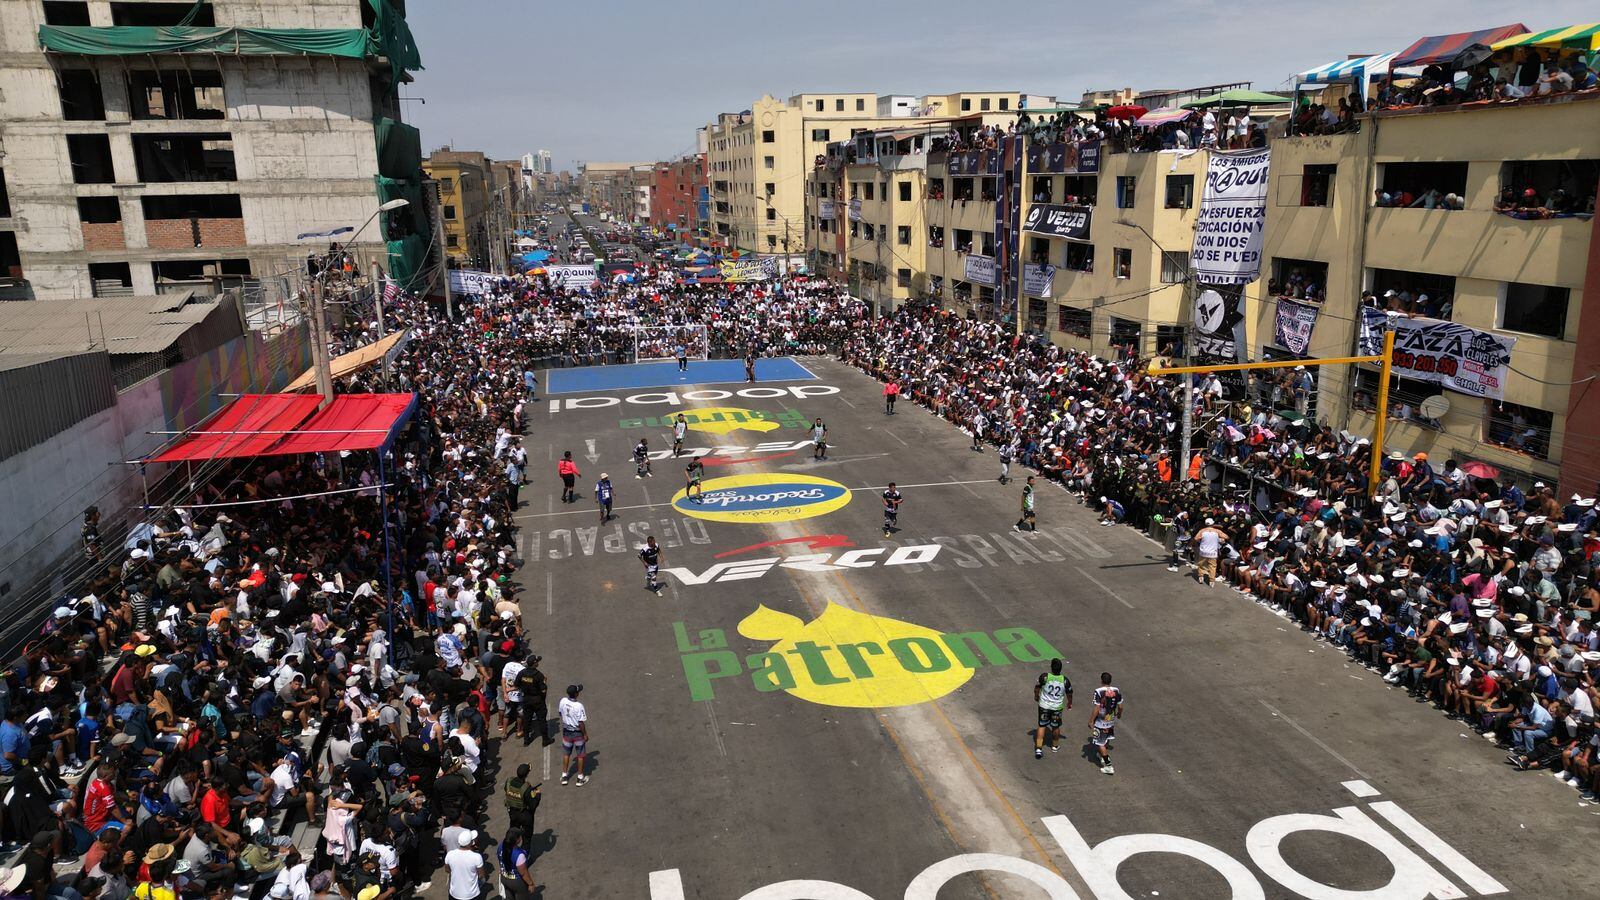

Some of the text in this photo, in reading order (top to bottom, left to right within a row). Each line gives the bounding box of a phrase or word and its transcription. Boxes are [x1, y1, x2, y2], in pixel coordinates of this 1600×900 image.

[1230, 153, 1268, 166] AMIGOS
[1197, 219, 1253, 233] EDICACIÓN
[1217, 236, 1249, 249] DIOS
[1207, 250, 1221, 262] SE
[1223, 250, 1260, 263] PUED
[549, 384, 841, 413] doobai
[672, 621, 729, 652] La
[680, 627, 1066, 702] Patrona
[1048, 684, 1061, 698] 22
[648, 779, 1510, 900] bai
